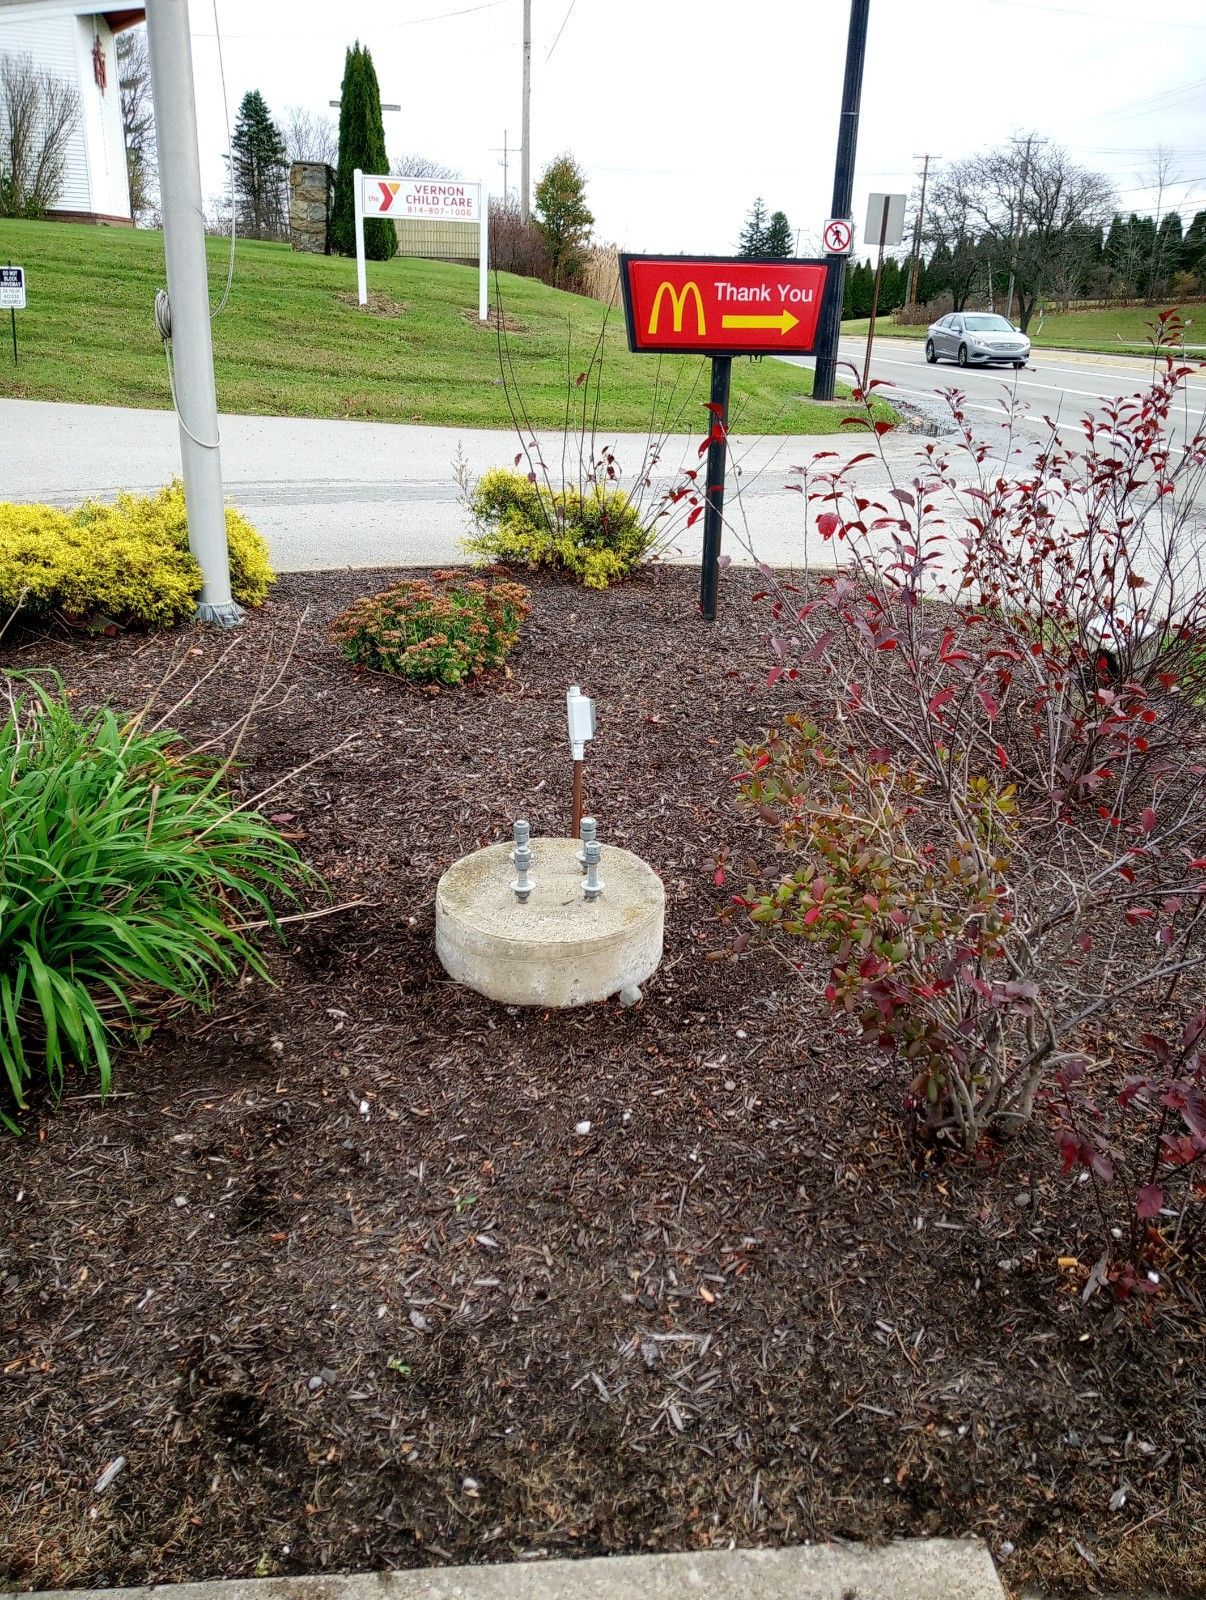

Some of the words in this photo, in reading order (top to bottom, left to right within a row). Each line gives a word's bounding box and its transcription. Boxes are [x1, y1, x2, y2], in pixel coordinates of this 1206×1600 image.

[414, 184, 464, 196] VERNON
[405, 194, 440, 205] CHILD
[443, 197, 473, 208] CARE
[407, 206, 472, 216] 814-807-1006
[714, 282, 771, 302] Thank
[777, 284, 813, 303] You
